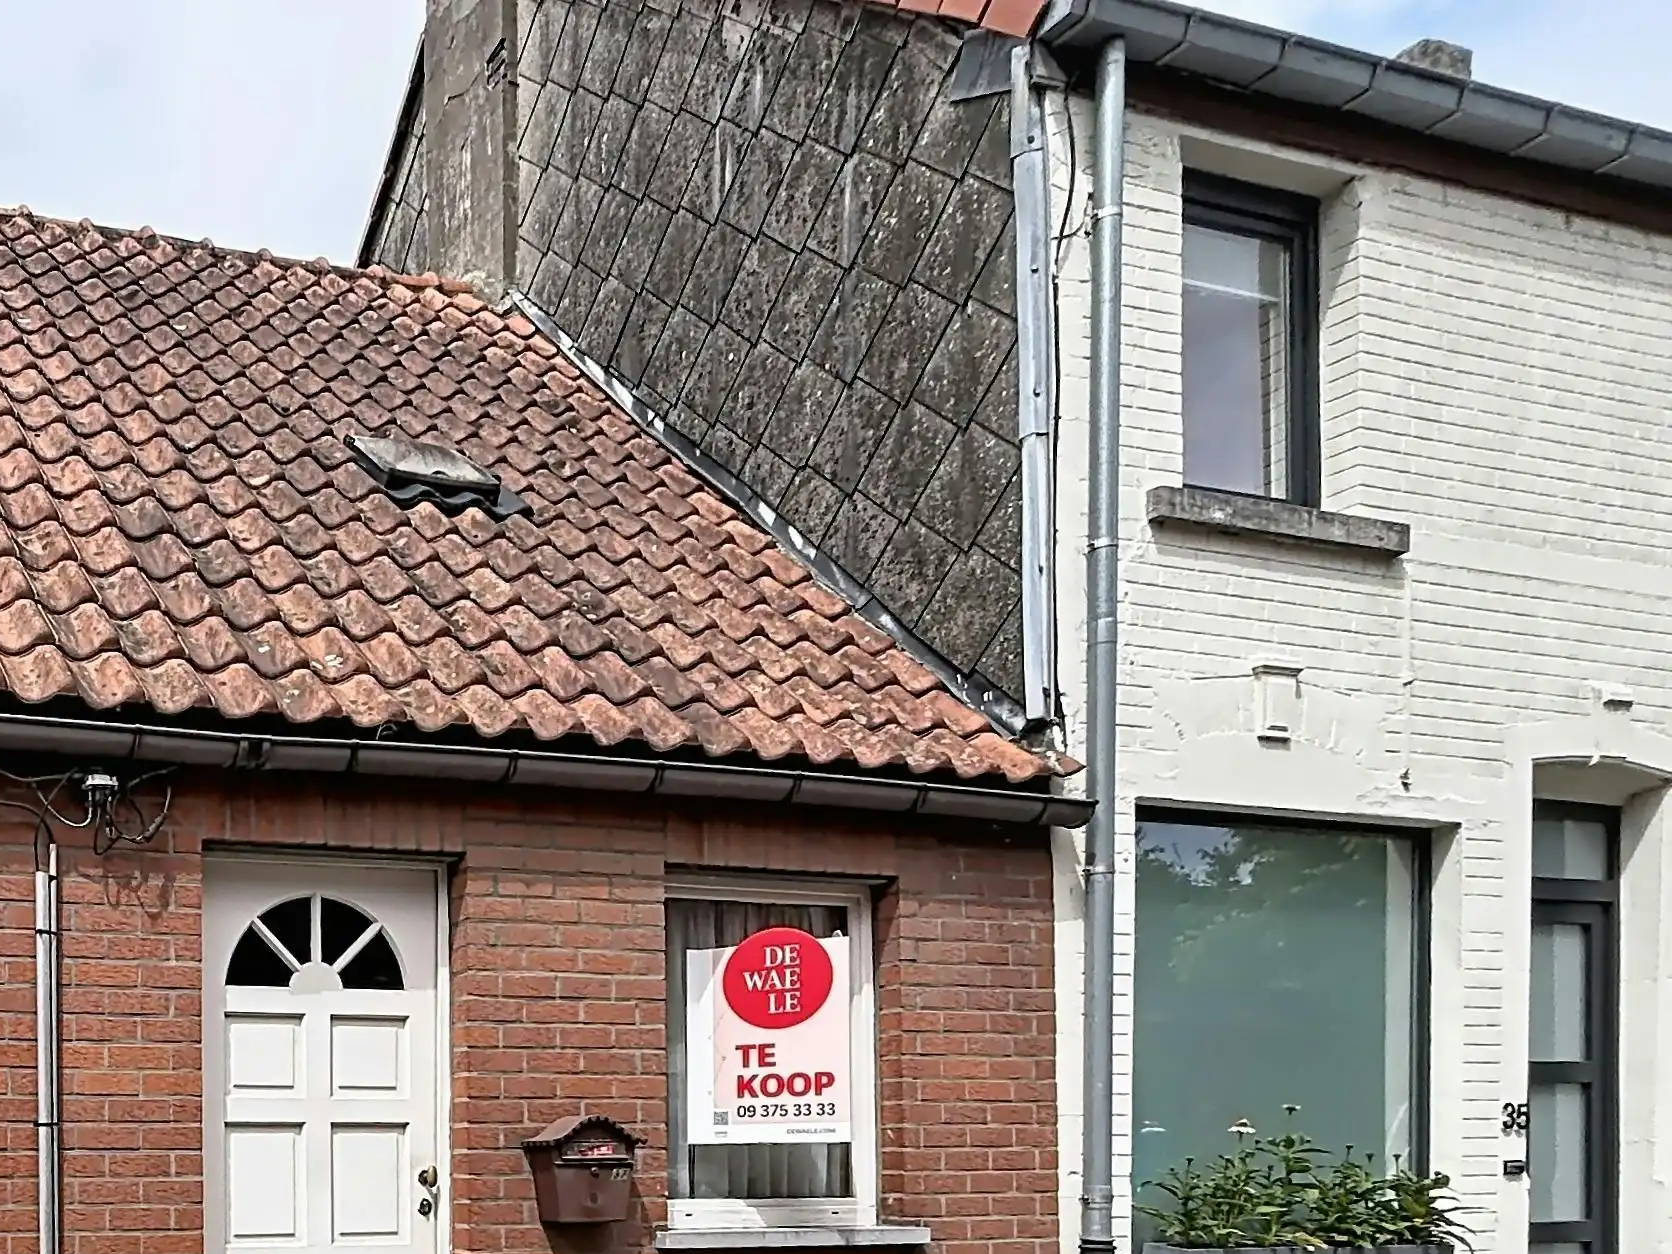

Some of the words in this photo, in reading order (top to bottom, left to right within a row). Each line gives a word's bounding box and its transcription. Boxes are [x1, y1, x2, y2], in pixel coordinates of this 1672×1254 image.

[764, 944, 801, 968] DE
[743, 967, 801, 992] WAE
[768, 991, 801, 1014] LE
[735, 1043, 776, 1068] TE
[736, 1071, 836, 1099] KOOP
[736, 1104, 757, 1118] 09
[760, 1103, 788, 1118] 375
[793, 1103, 812, 1117] 33
[816, 1102, 836, 1116] 33
[1502, 1102, 1530, 1130] 35
